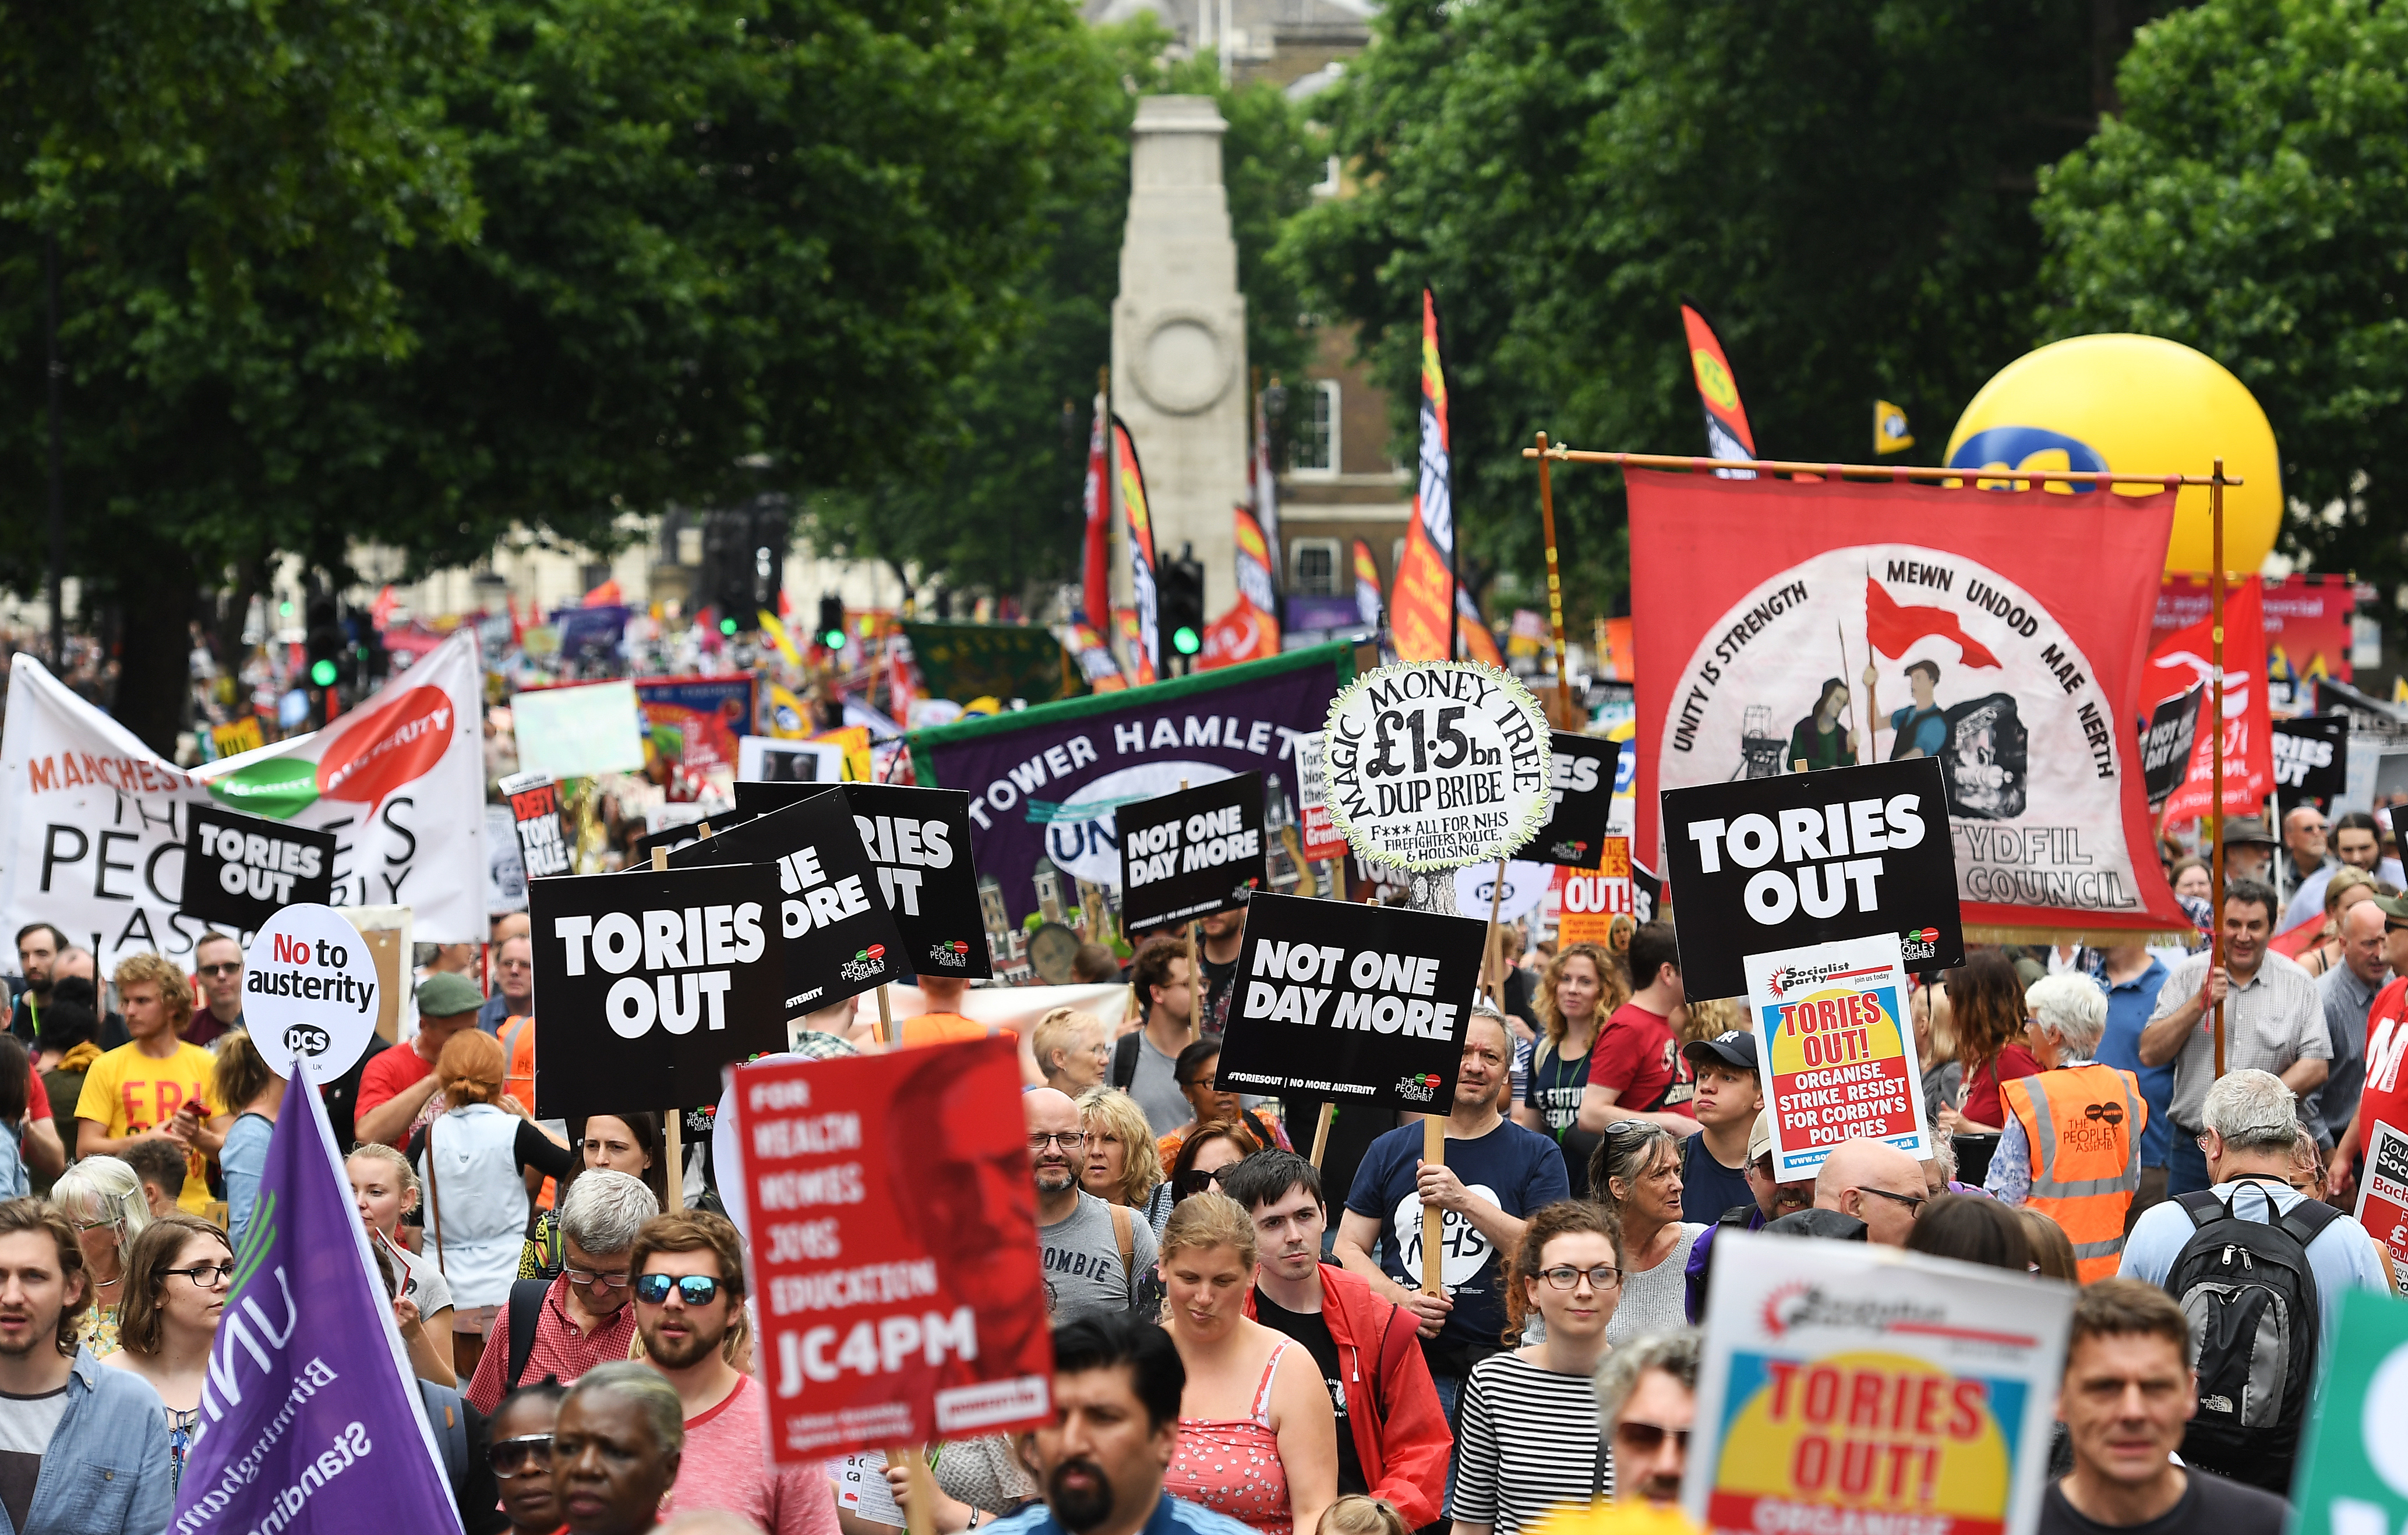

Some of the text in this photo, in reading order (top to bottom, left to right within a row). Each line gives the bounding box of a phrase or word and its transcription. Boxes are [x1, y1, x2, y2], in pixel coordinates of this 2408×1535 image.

[1673, 581, 1809, 752] UNITY IS STRENGTH
[1887, 560, 1954, 592] MEWN
[1965, 579, 2039, 638] UNDOD
[2040, 643, 2086, 695] MAE
[2077, 702, 2115, 779] NERTH
[1331, 669, 1541, 823] MAGIC MONEY TREE
[968, 715, 1302, 831] TOWER HAMLET
[1375, 770, 1506, 818] DUP BRIBE
[1127, 805, 1242, 861] NOT ONE
[1415, 819, 1438, 836] ALL
[1440, 816, 1470, 832] FOR
[1473, 811, 1509, 829] NHS
[1459, 828, 1503, 845] POLICE,
[1688, 794, 1926, 874] TORIES
[197, 822, 323, 880] TORIES
[1128, 829, 1260, 888] DAY MORE
[1418, 844, 1480, 861] HOUSING
[220, 862, 298, 905] OUT
[1565, 875, 1630, 913] OUT!
[1743, 857, 1885, 926] OUT
[1967, 866, 2137, 908] COUNCIL
[782, 873, 872, 939] ORE
[273, 933, 348, 968] No to
[555, 901, 766, 977] TORIES
[932, 945, 945, 953] THE
[1899, 938, 1911, 946] HE
[1902, 950, 1935, 961] ASSEMBLY
[842, 959, 859, 972] THE
[853, 964, 885, 982] ASSEMBLY
[938, 959, 966, 967] ASSEMBLY
[1251, 938, 1440, 997] NOT ONE
[1785, 962, 1850, 979] Socialist
[1855, 976, 1865, 985] join
[1874, 972, 1890, 983] today
[247, 970, 375, 1013] austerity
[785, 986, 824, 1009] STERITY
[1782, 975, 1828, 992] Party
[605, 970, 732, 1039] OUT
[1242, 980, 1458, 1041] DAY MORE
[1779, 992, 1881, 1037] TORIES
[288, 1029, 327, 1052] pcs
[1802, 1028, 1870, 1067] OUT!
[1227, 1071, 1377, 1095] #TORIESOUT NO MORE AUSTERITY
[1400, 1077, 1415, 1086] THE
[1779, 1077, 1906, 1112] STRIKE, RESIST
[1795, 1062, 1886, 1090] ORGANISE,
[749, 1079, 810, 1112] FOR
[1401, 1092, 1433, 1102] ASSEMBLY
[1784, 1097, 1907, 1130] FOR CORBYN'S
[688, 1112, 699, 1120] THE
[753, 1111, 862, 1159] HEALTH
[1809, 1118, 1888, 1145] POLICIES
[2068, 1118, 2089, 1130] THE
[758, 1165, 865, 1210] HOMES
[765, 1217, 841, 1264] JOBS
[1044, 1247, 1111, 1283] OMBIE
[768, 1257, 937, 1317] EDUCATION
[776, 1305, 978, 1397] JC4PM
[1765, 1359, 1988, 1442] TORIES
[2200, 1398, 2224, 1406] NORTH
[1791, 1431, 1944, 1504] OUT!
